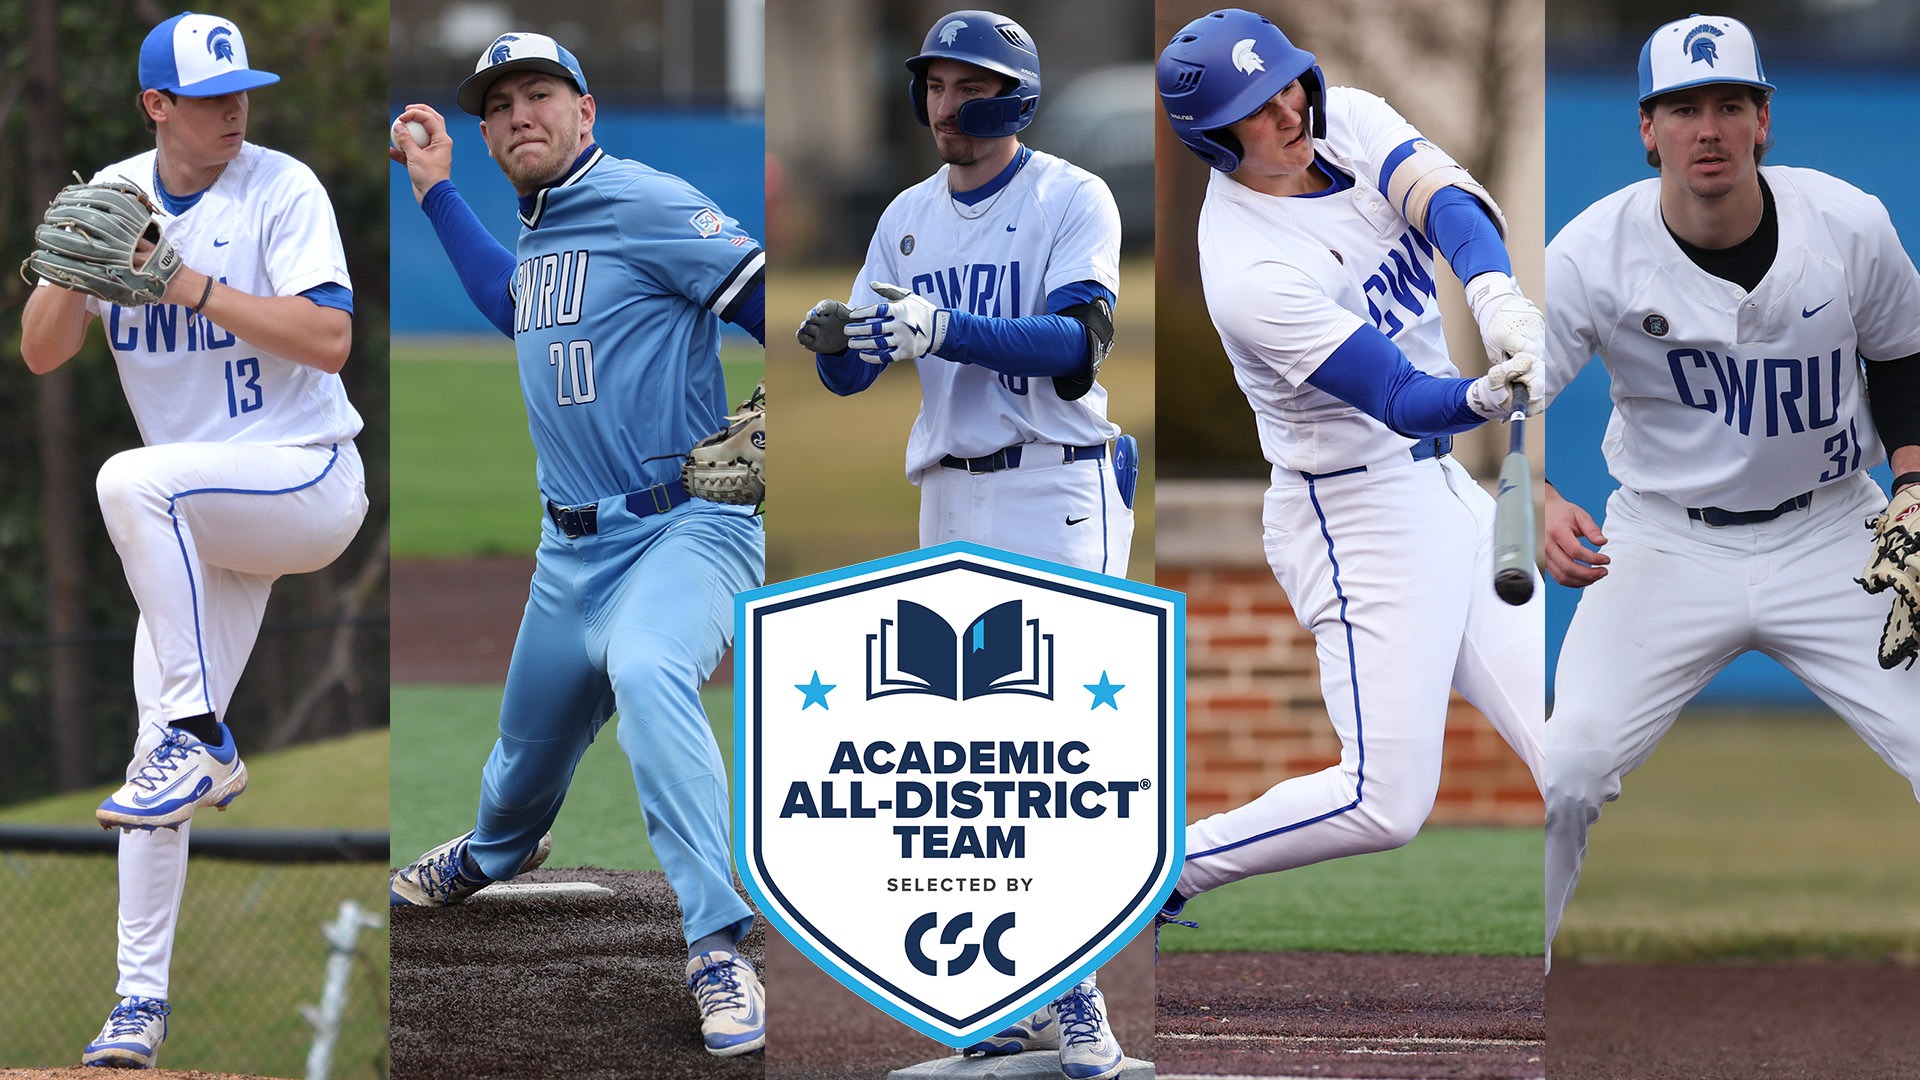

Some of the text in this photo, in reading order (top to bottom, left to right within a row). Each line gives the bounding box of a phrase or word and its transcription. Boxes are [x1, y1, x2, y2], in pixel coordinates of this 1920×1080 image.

[516, 250, 589, 333] WRU
[225, 357, 263, 418] 13
[549, 339, 597, 406] 20
[1667, 348, 1841, 437] CWRU
[1819, 416, 1861, 482] 31
